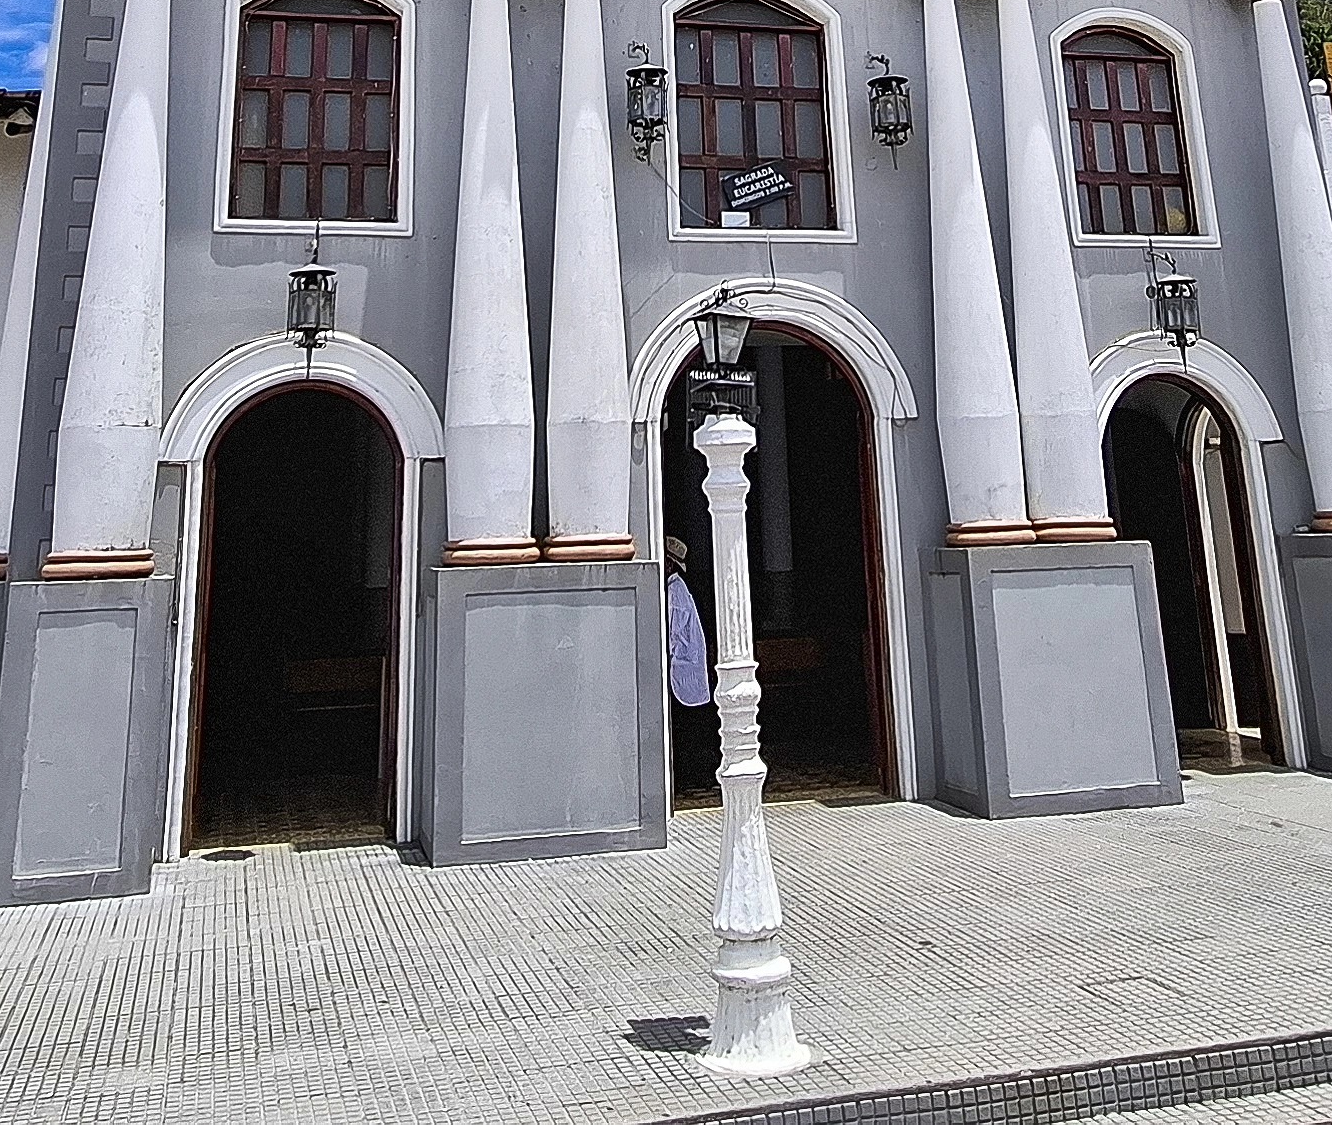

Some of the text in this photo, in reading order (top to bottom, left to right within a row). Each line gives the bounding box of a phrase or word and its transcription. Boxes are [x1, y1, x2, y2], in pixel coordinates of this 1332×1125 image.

[734, 167, 774, 186] SAGRADA
[734, 173, 785, 197] EUCARISTÍA
[731, 191, 765, 207] DOMINGOS
